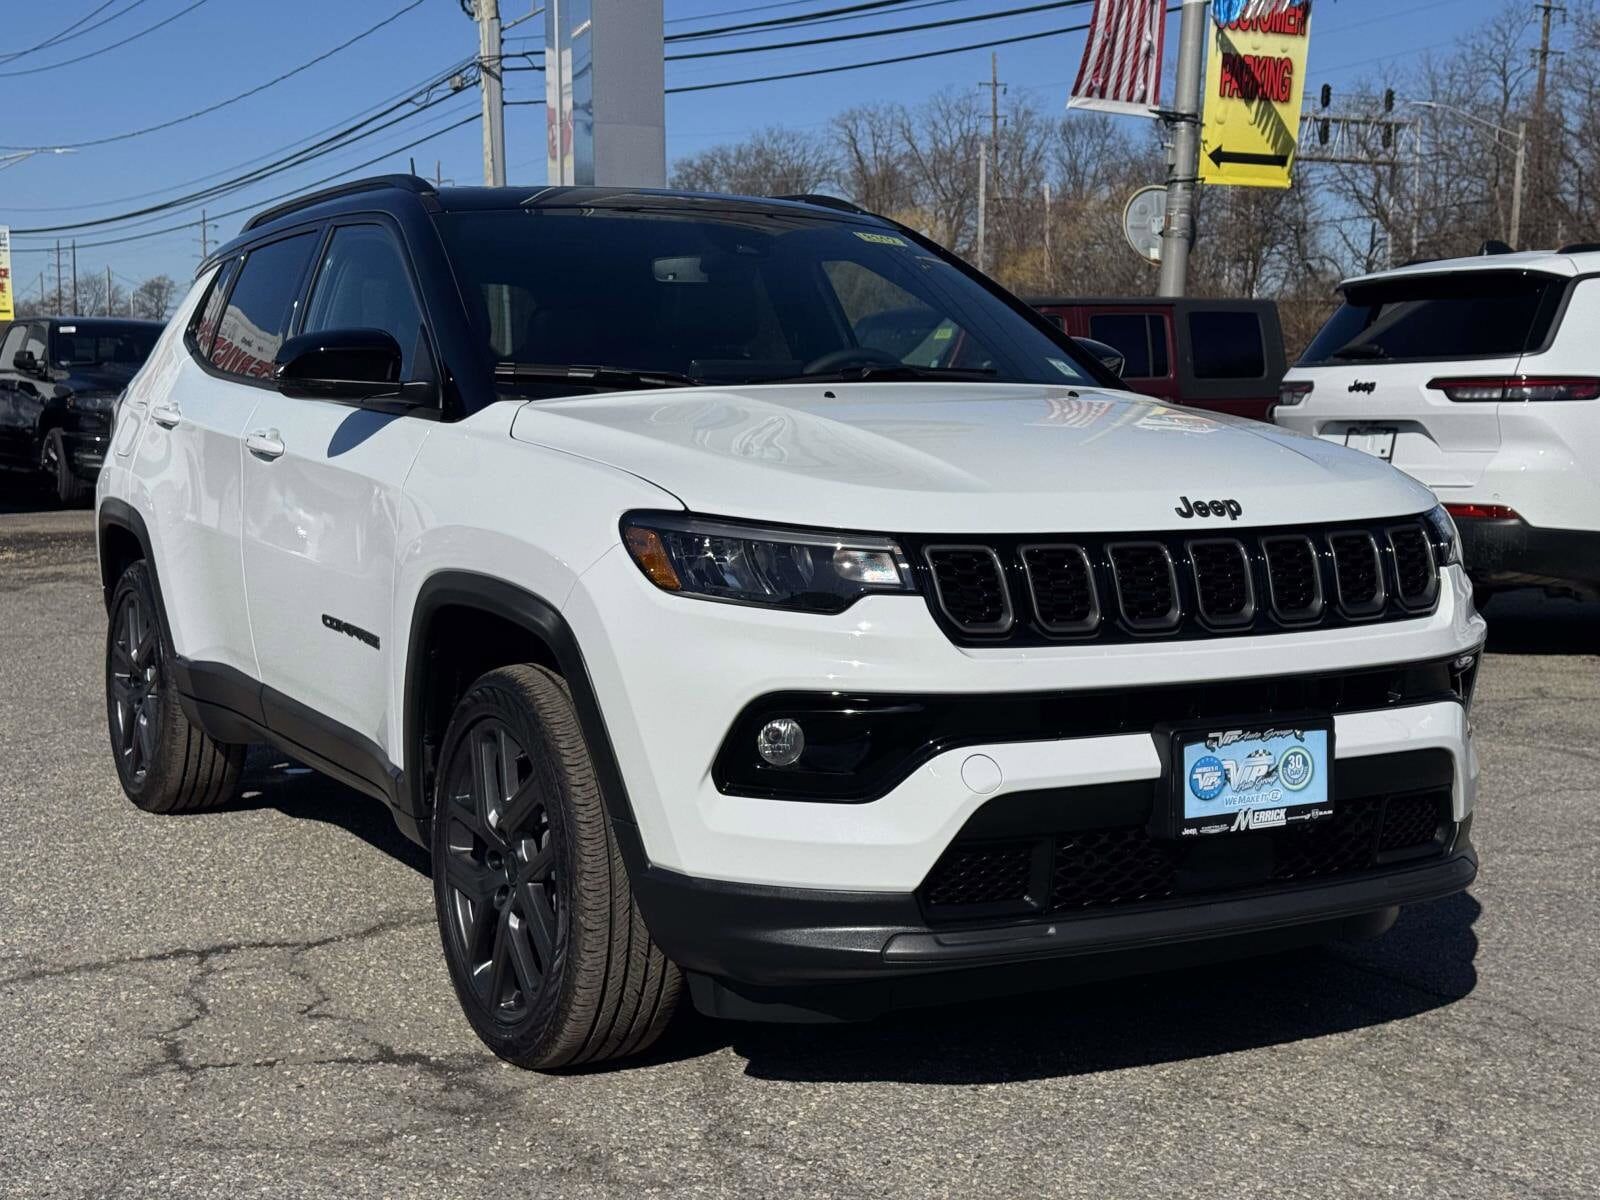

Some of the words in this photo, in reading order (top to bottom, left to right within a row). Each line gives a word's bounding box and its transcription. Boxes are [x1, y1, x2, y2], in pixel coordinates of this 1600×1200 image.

[1219, 5, 1305, 35] OMER
[1220, 54, 1293, 102] PARKING
[1348, 379, 1376, 395] Jeep
[1175, 496, 1243, 521] Jeep
[1208, 730, 1242, 747] VIP
[1288, 754, 1303, 769] 30
[1222, 757, 1272, 791] VIP
[1181, 827, 1198, 836] Jeep
